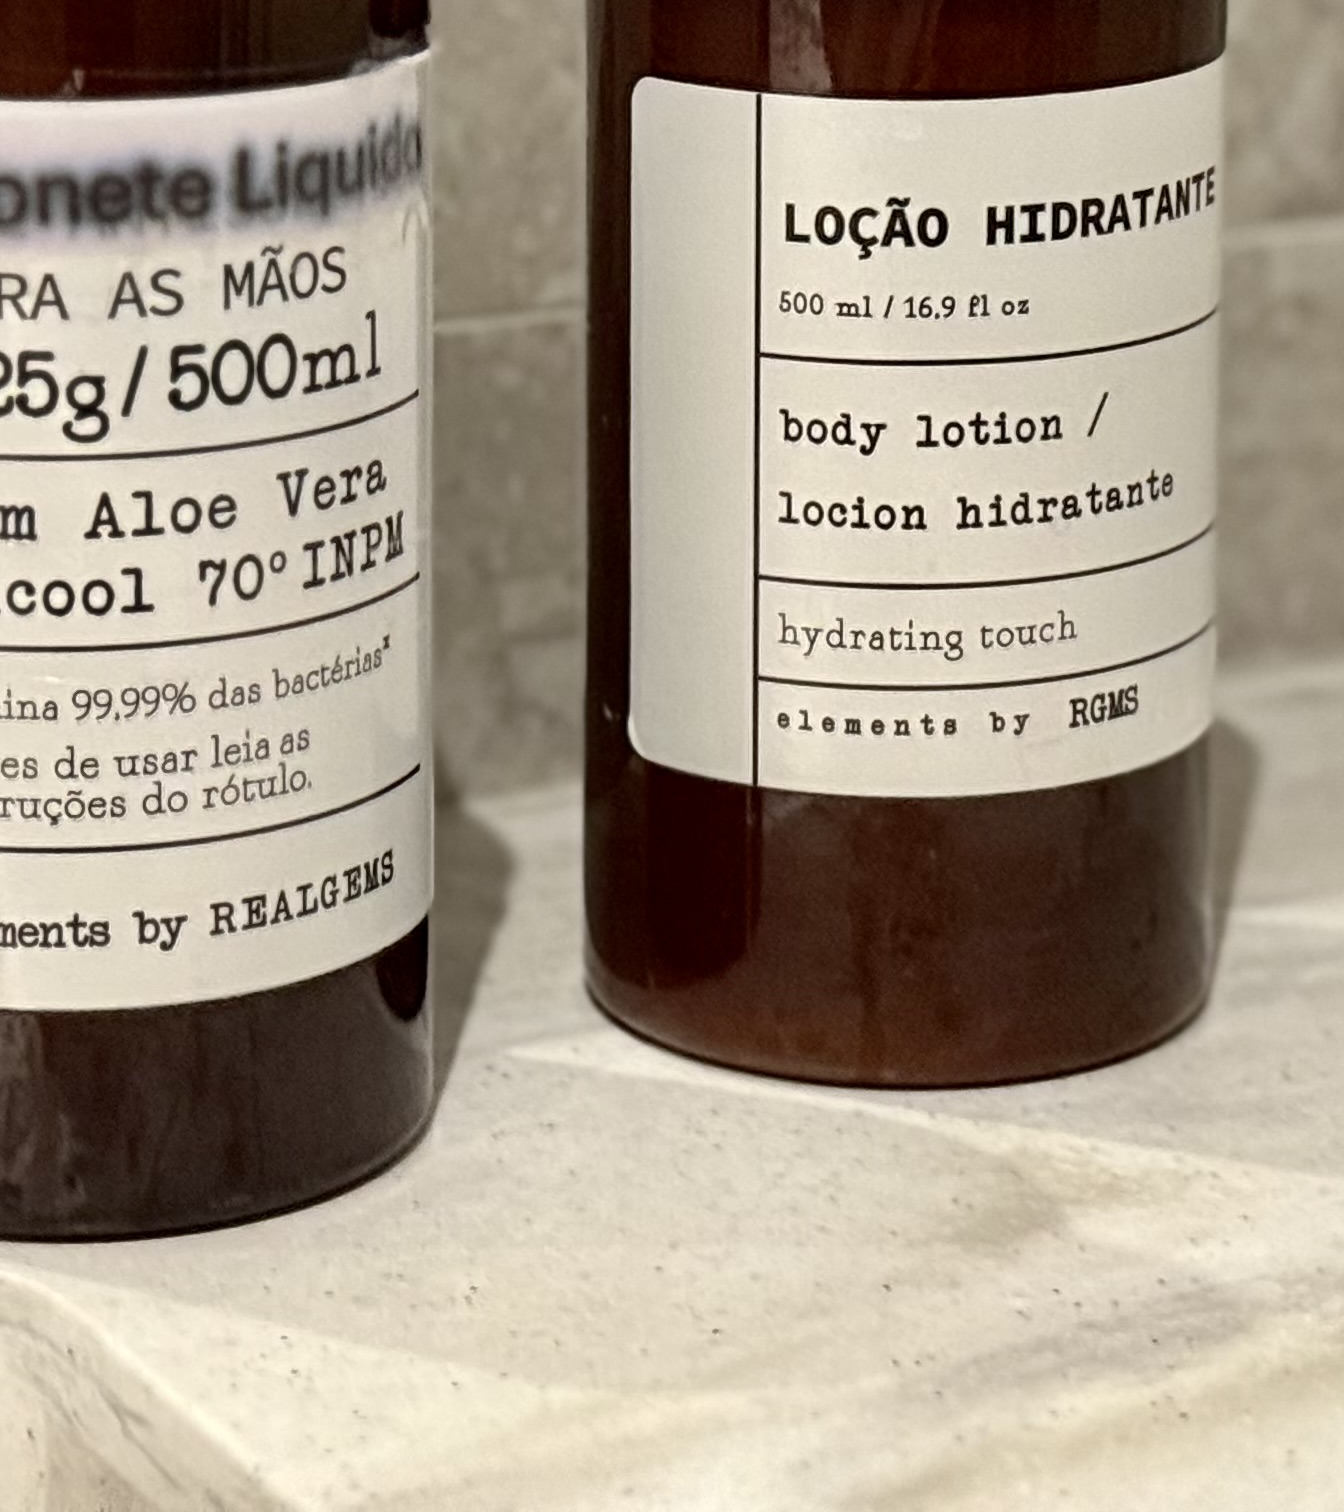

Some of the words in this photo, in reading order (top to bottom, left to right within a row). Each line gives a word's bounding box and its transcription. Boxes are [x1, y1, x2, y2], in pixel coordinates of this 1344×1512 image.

[784, 195, 950, 262] LOÇÃO
[985, 165, 1216, 248] HIDRATANTE
[106, 267, 186, 321] AS
[222, 242, 348, 312] MÃOS
[778, 289, 827, 317] 500
[833, 294, 876, 320] ml
[881, 293, 896, 325] /
[901, 294, 957, 324] 16.9
[967, 292, 993, 322] fl
[1000, 298, 1030, 317] oz
[778, 407, 889, 457] body
[915, 410, 1064, 449] lotion
[1086, 390, 1110, 439] /
[82, 489, 239, 542] Aloe
[275, 458, 388, 521] Vera
[777, 489, 931, 533] locion
[955, 468, 1174, 531] hidratante
[301, 509, 405, 592] INPM
[776, 611, 965, 664] hydrating
[979, 608, 1079, 651] touch
[207, 674, 263, 713] das
[776, 708, 959, 739] elements
[987, 710, 1031, 740] by
[1068, 682, 1140, 730] RGMS
[53, 743, 101, 784] de
[112, 747, 200, 781] usar
[209, 727, 272, 770] leia
[279, 728, 311, 759] as
[140, 779, 189, 820] do
[201, 759, 313, 812] rótulo.
[130, 909, 189, 953] by
[208, 847, 395, 939] REALGEMS
